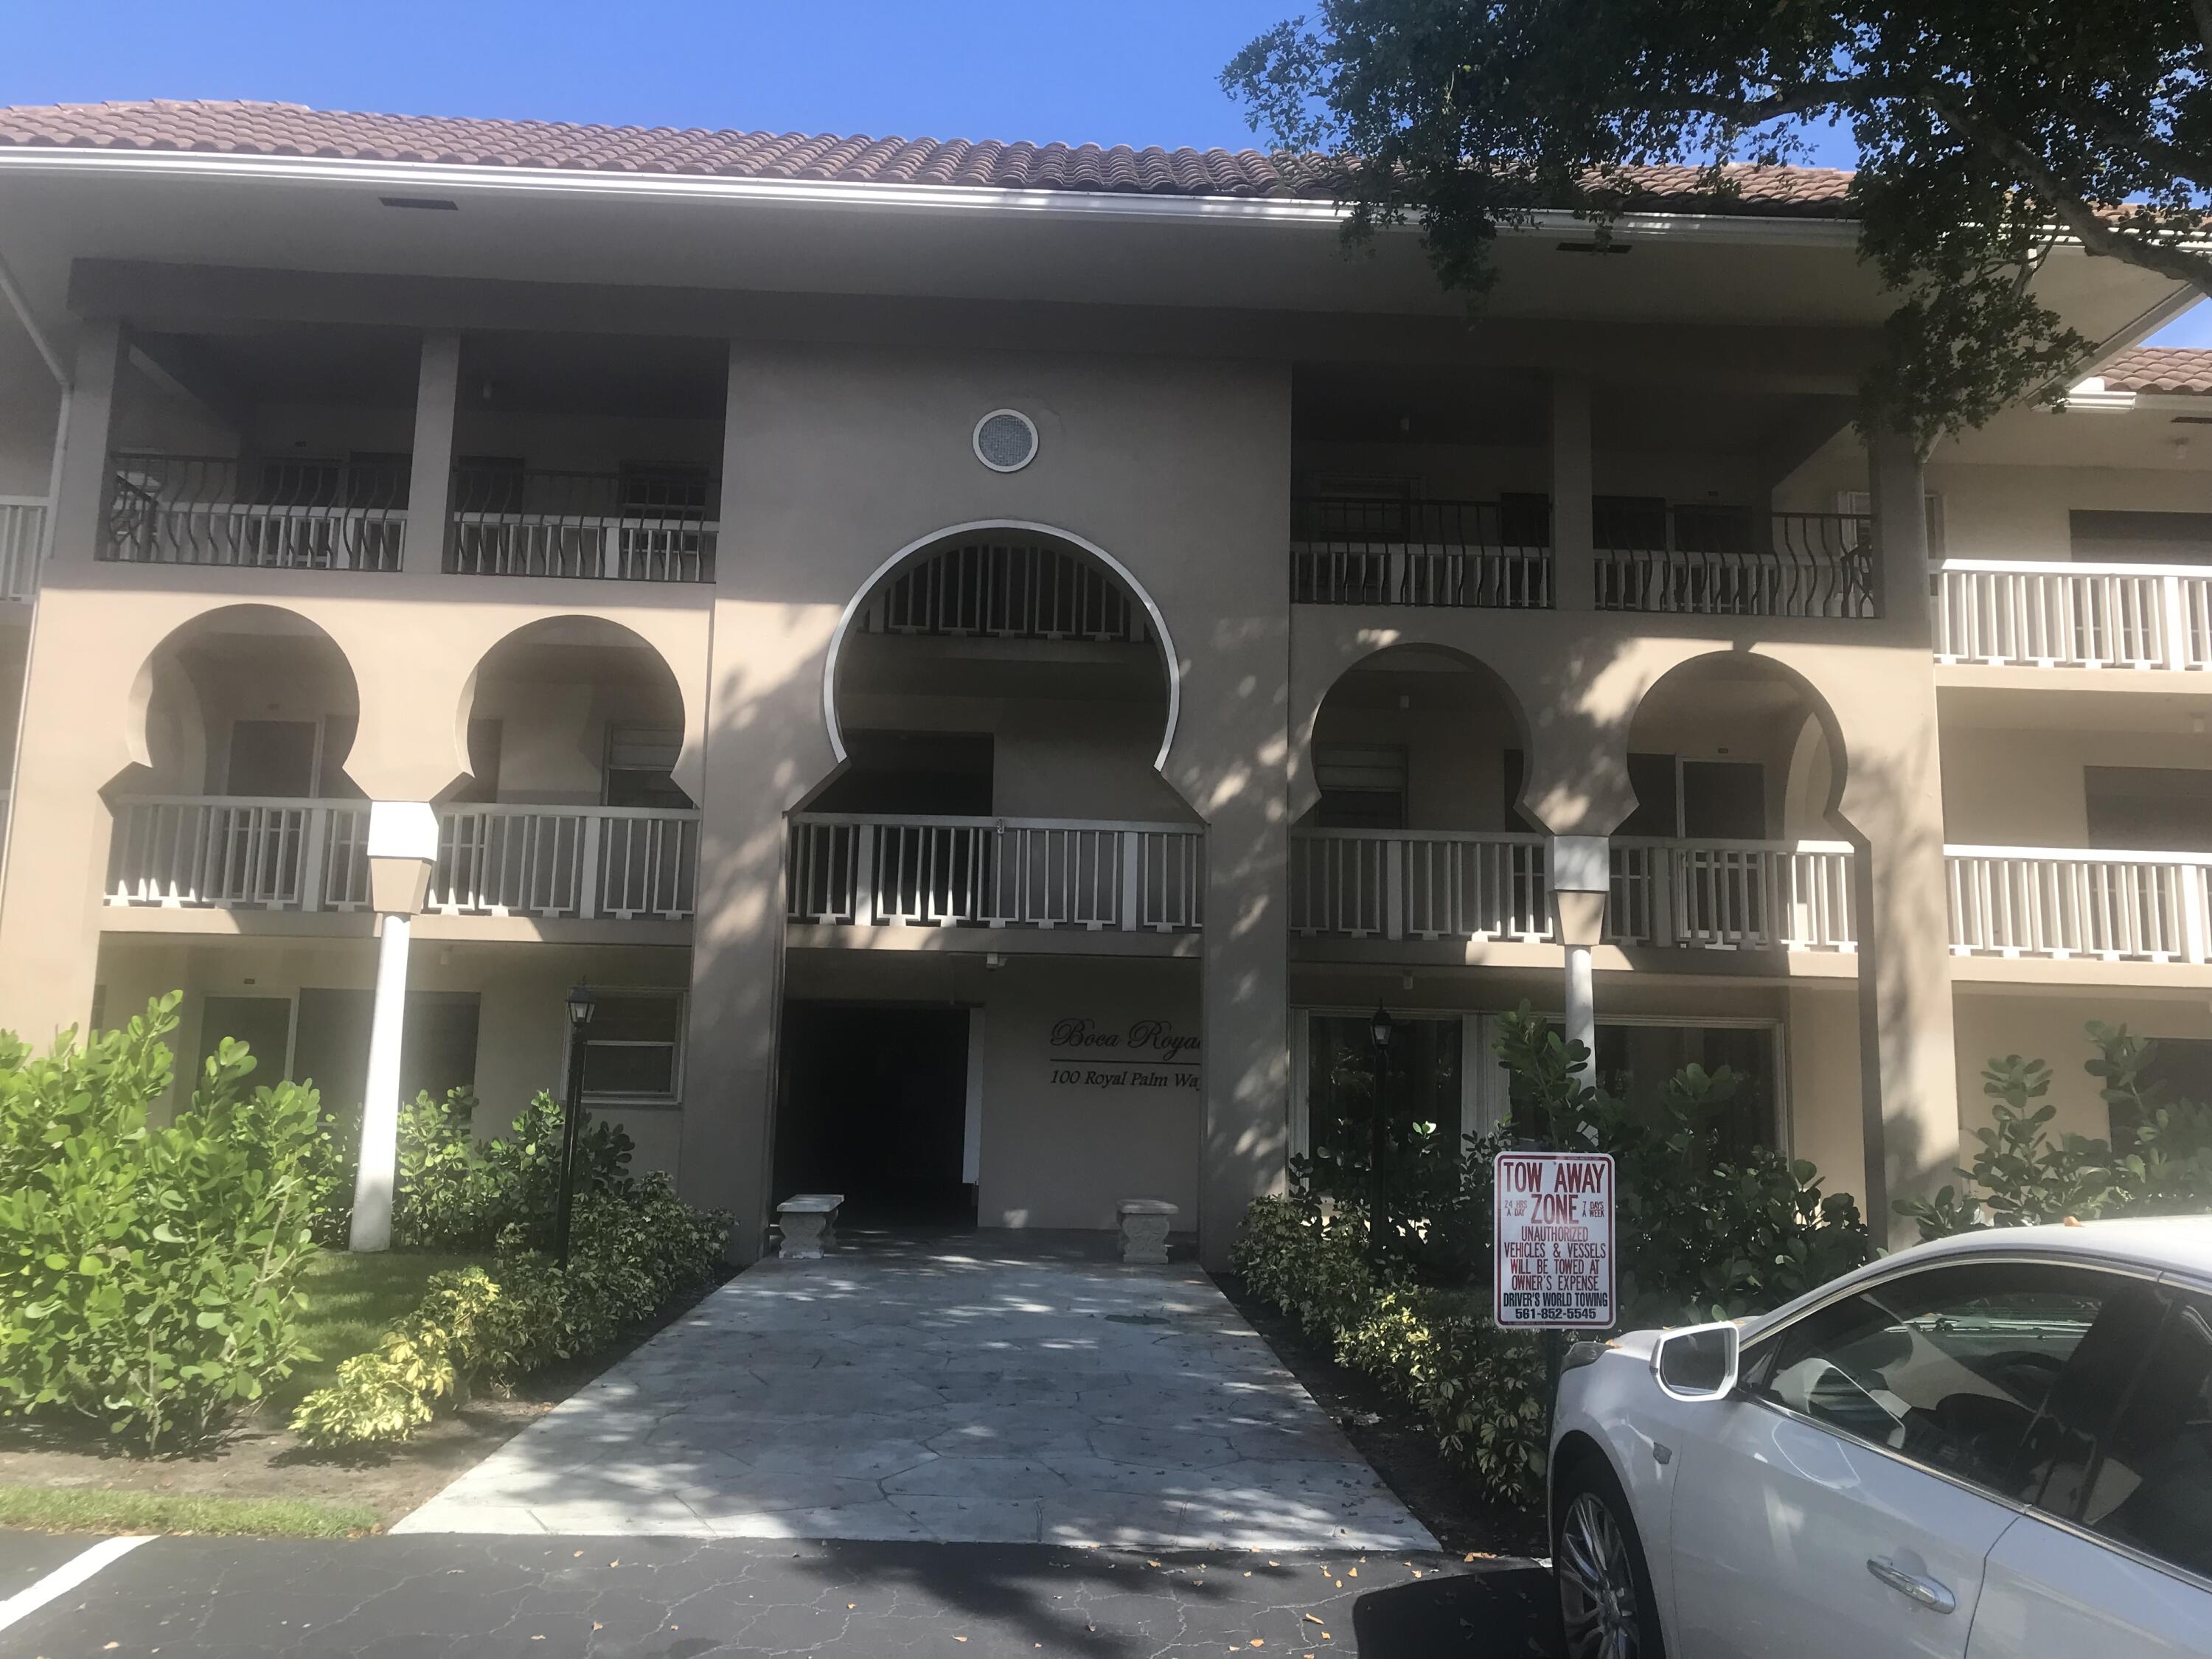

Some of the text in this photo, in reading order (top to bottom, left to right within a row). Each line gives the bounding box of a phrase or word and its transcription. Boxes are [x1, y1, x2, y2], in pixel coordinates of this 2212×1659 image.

[1050, 1018, 1200, 1061] Boca Roya
[1051, 1071, 1200, 1091] 100 Royal Palm Wa
[1503, 1162, 1605, 1193] TOW AWAY
[1504, 1200, 1527, 1208] 24 HRS
[1531, 1194, 1579, 1224] ZONE
[1583, 1201, 1587, 1210] 7
[1514, 1208, 1525, 1217] DAY
[1582, 1209, 1604, 1217] A WEEK
[1522, 1226, 1588, 1242] UNAUTHORIZED
[1504, 1242, 1606, 1258] VEHICLES & VESSELS
[1511, 1259, 1599, 1275] WILL BE TOWED AT
[1512, 1276, 1599, 1290] OWNER'S EXPENSE
[1503, 1293, 1607, 1307] DRIVER'S WORLD TOWING
[1516, 1308, 1596, 1320] 561-852-5545
